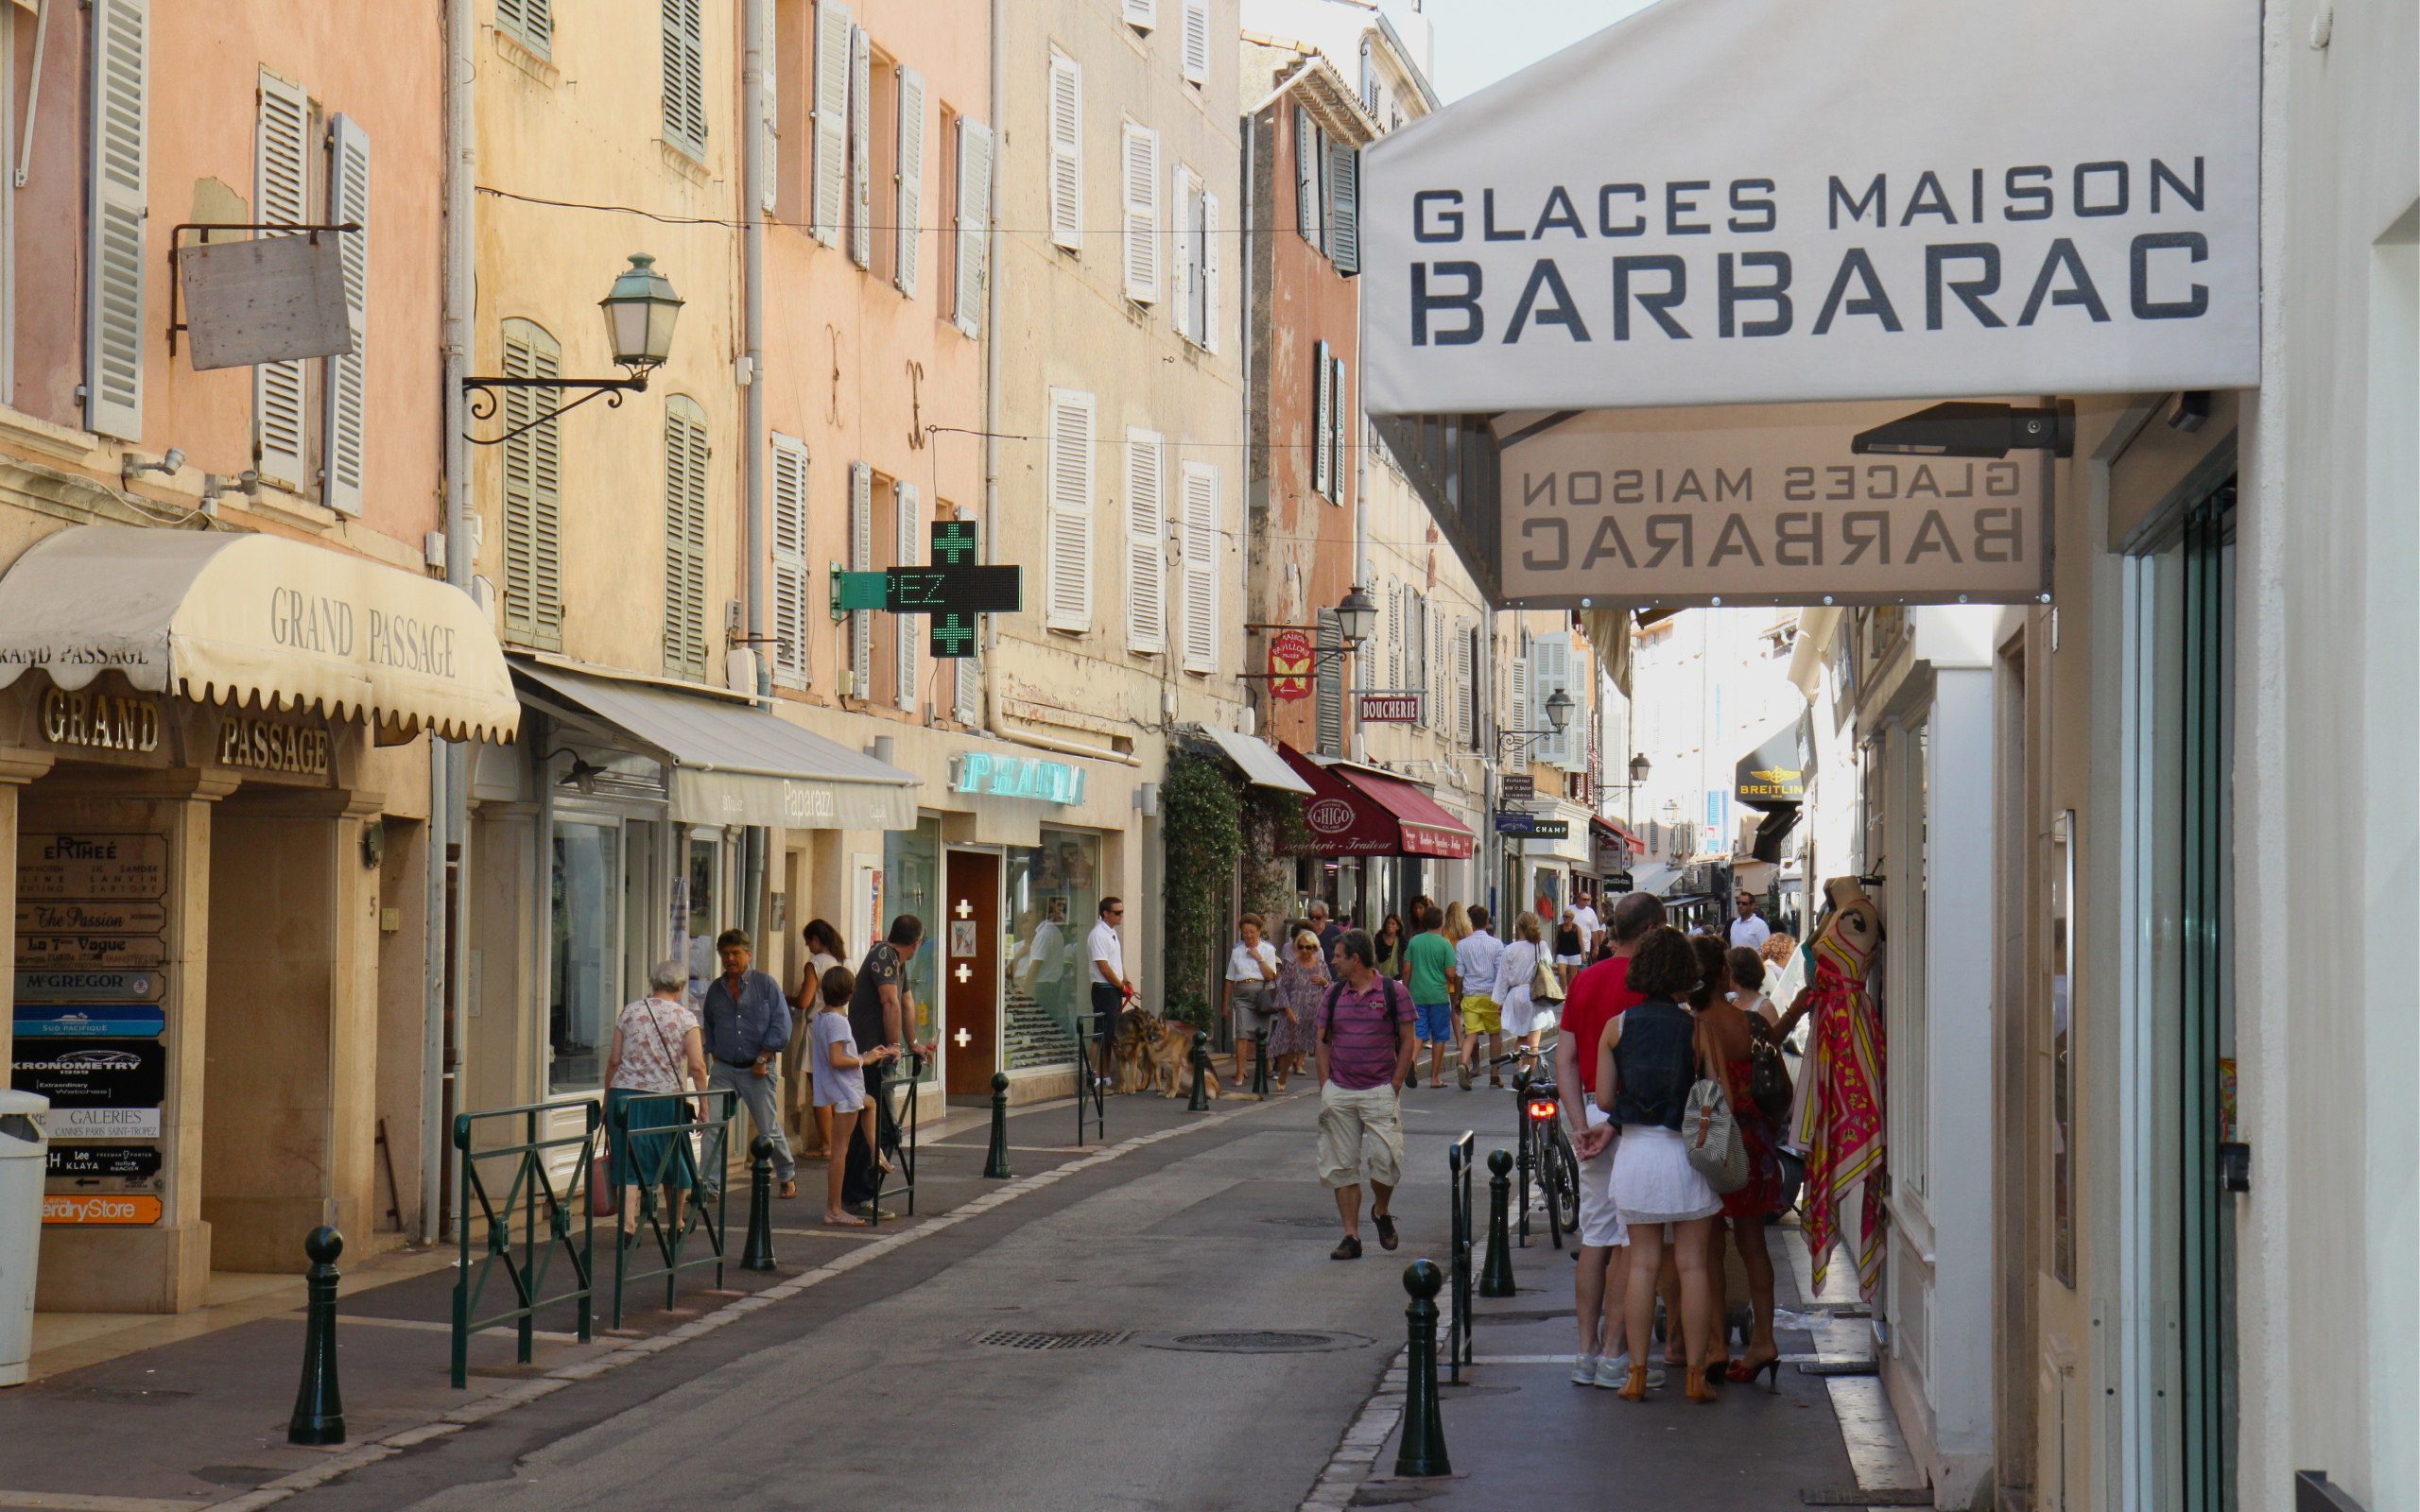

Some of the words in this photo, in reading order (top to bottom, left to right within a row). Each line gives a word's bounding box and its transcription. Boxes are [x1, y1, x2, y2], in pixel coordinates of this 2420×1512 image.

[1413, 178, 1777, 244] GLACES
[1828, 156, 2205, 230] MAISON
[1409, 231, 2210, 347] BARBARAC
[270, 586, 354, 657] GRAND
[368, 608, 456, 679] PASSAGE
[1362, 701, 1416, 718] BOUCHERIE
[44, 687, 159, 752] GRAND
[222, 716, 328, 776] PASSAGE
[1740, 785, 1804, 795] BREITLIN
[783, 779, 834, 825] Paparazzi
[1313, 807, 1350, 825] GHIGO
[1346, 836, 1392, 850] Traiteur
[120, 865, 158, 873] SANDER
[91, 875, 157, 884] LANVIN
[370, 895, 376, 917] 5
[34, 906, 63, 928] The
[66, 906, 126, 928] Passion
[27, 937, 46, 951] La
[78, 936, 126, 953] Vague
[11, 1061, 140, 1071] KRONOMETRY
[70, 1109, 142, 1125] GALERIES
[55, 1126, 83, 1137] CANNES
[85, 1126, 105, 1137] PARIS
[108, 1126, 157, 1137] SAINT-TROPEZ
[75, 1150, 90, 1160] Lee
